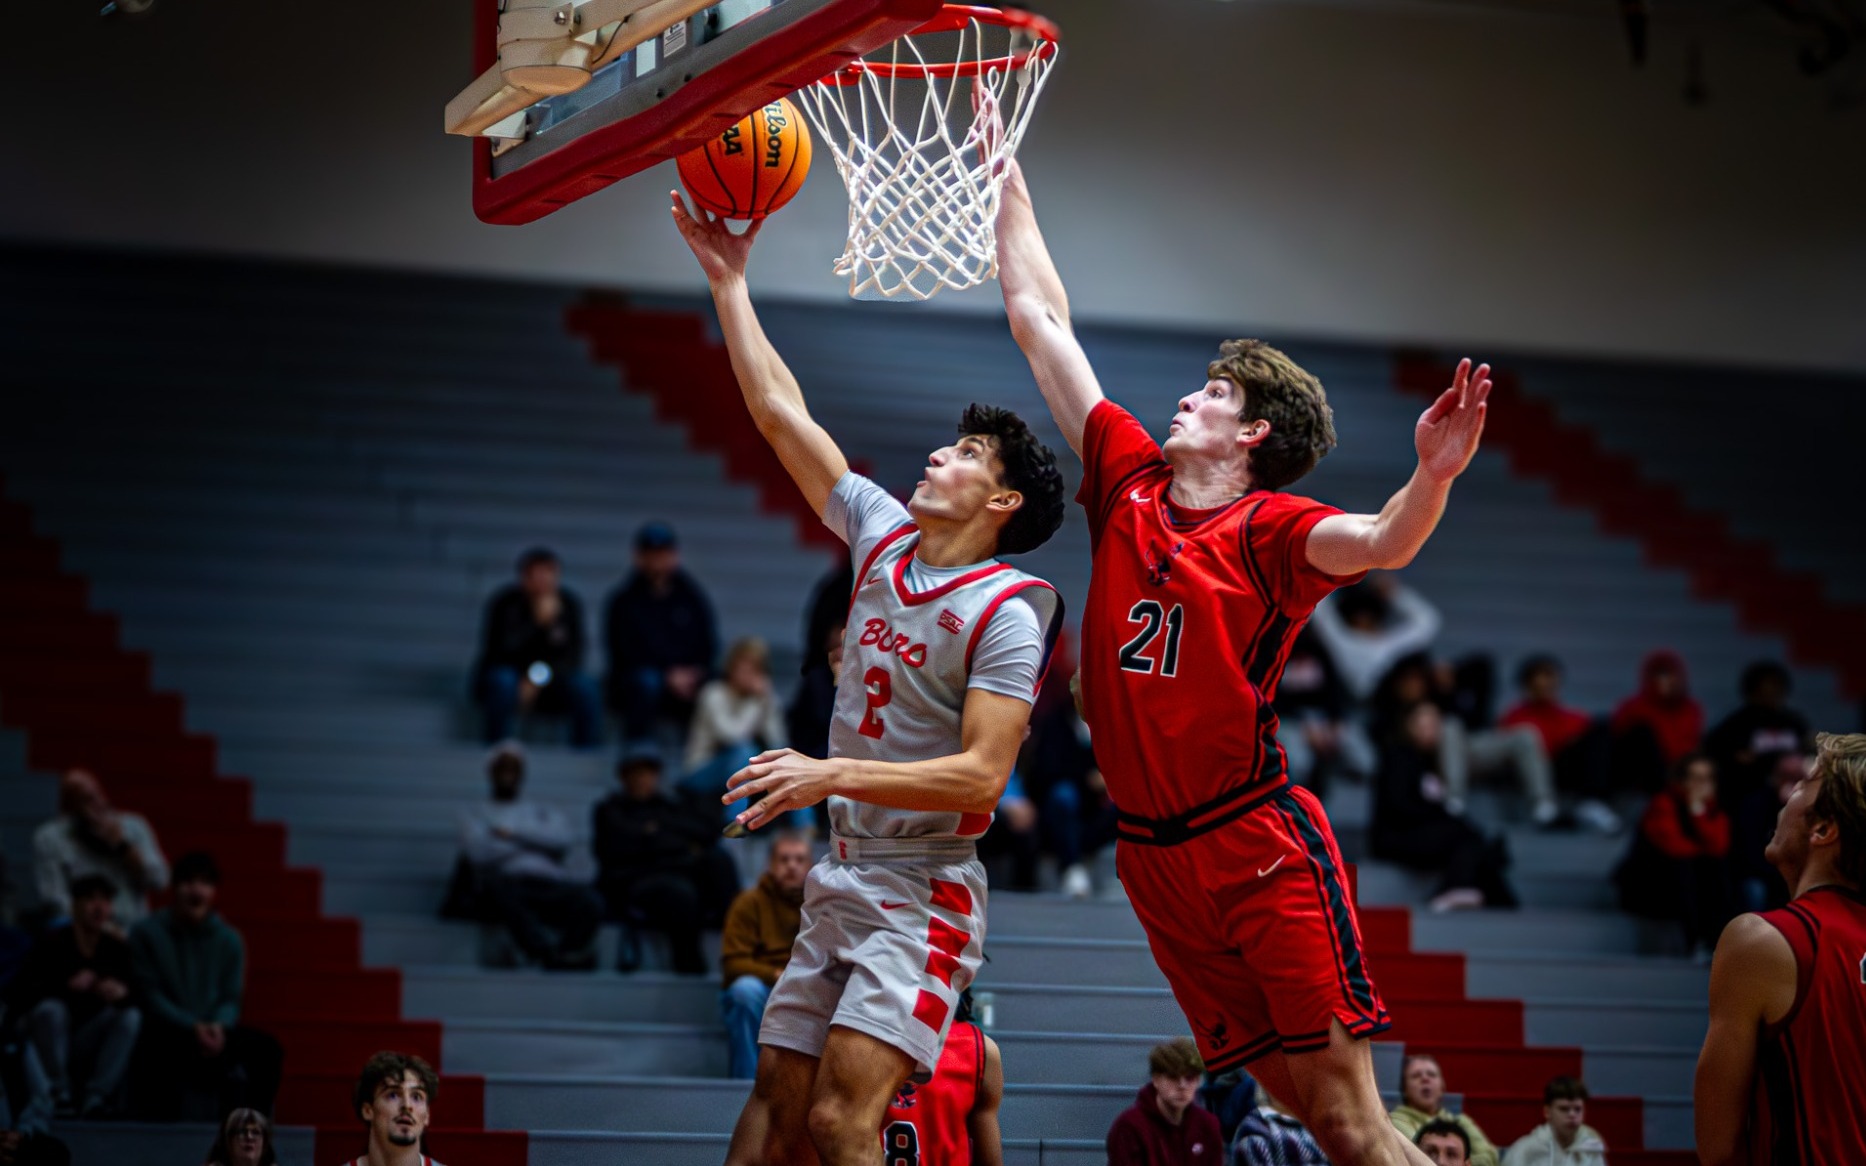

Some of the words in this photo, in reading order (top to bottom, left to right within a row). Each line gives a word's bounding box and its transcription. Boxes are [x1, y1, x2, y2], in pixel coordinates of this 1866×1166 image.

[858, 617, 928, 669] Boro
[940, 612, 964, 633] PSAC
[1119, 599, 1184, 678] 21
[857, 665, 892, 740] 2
